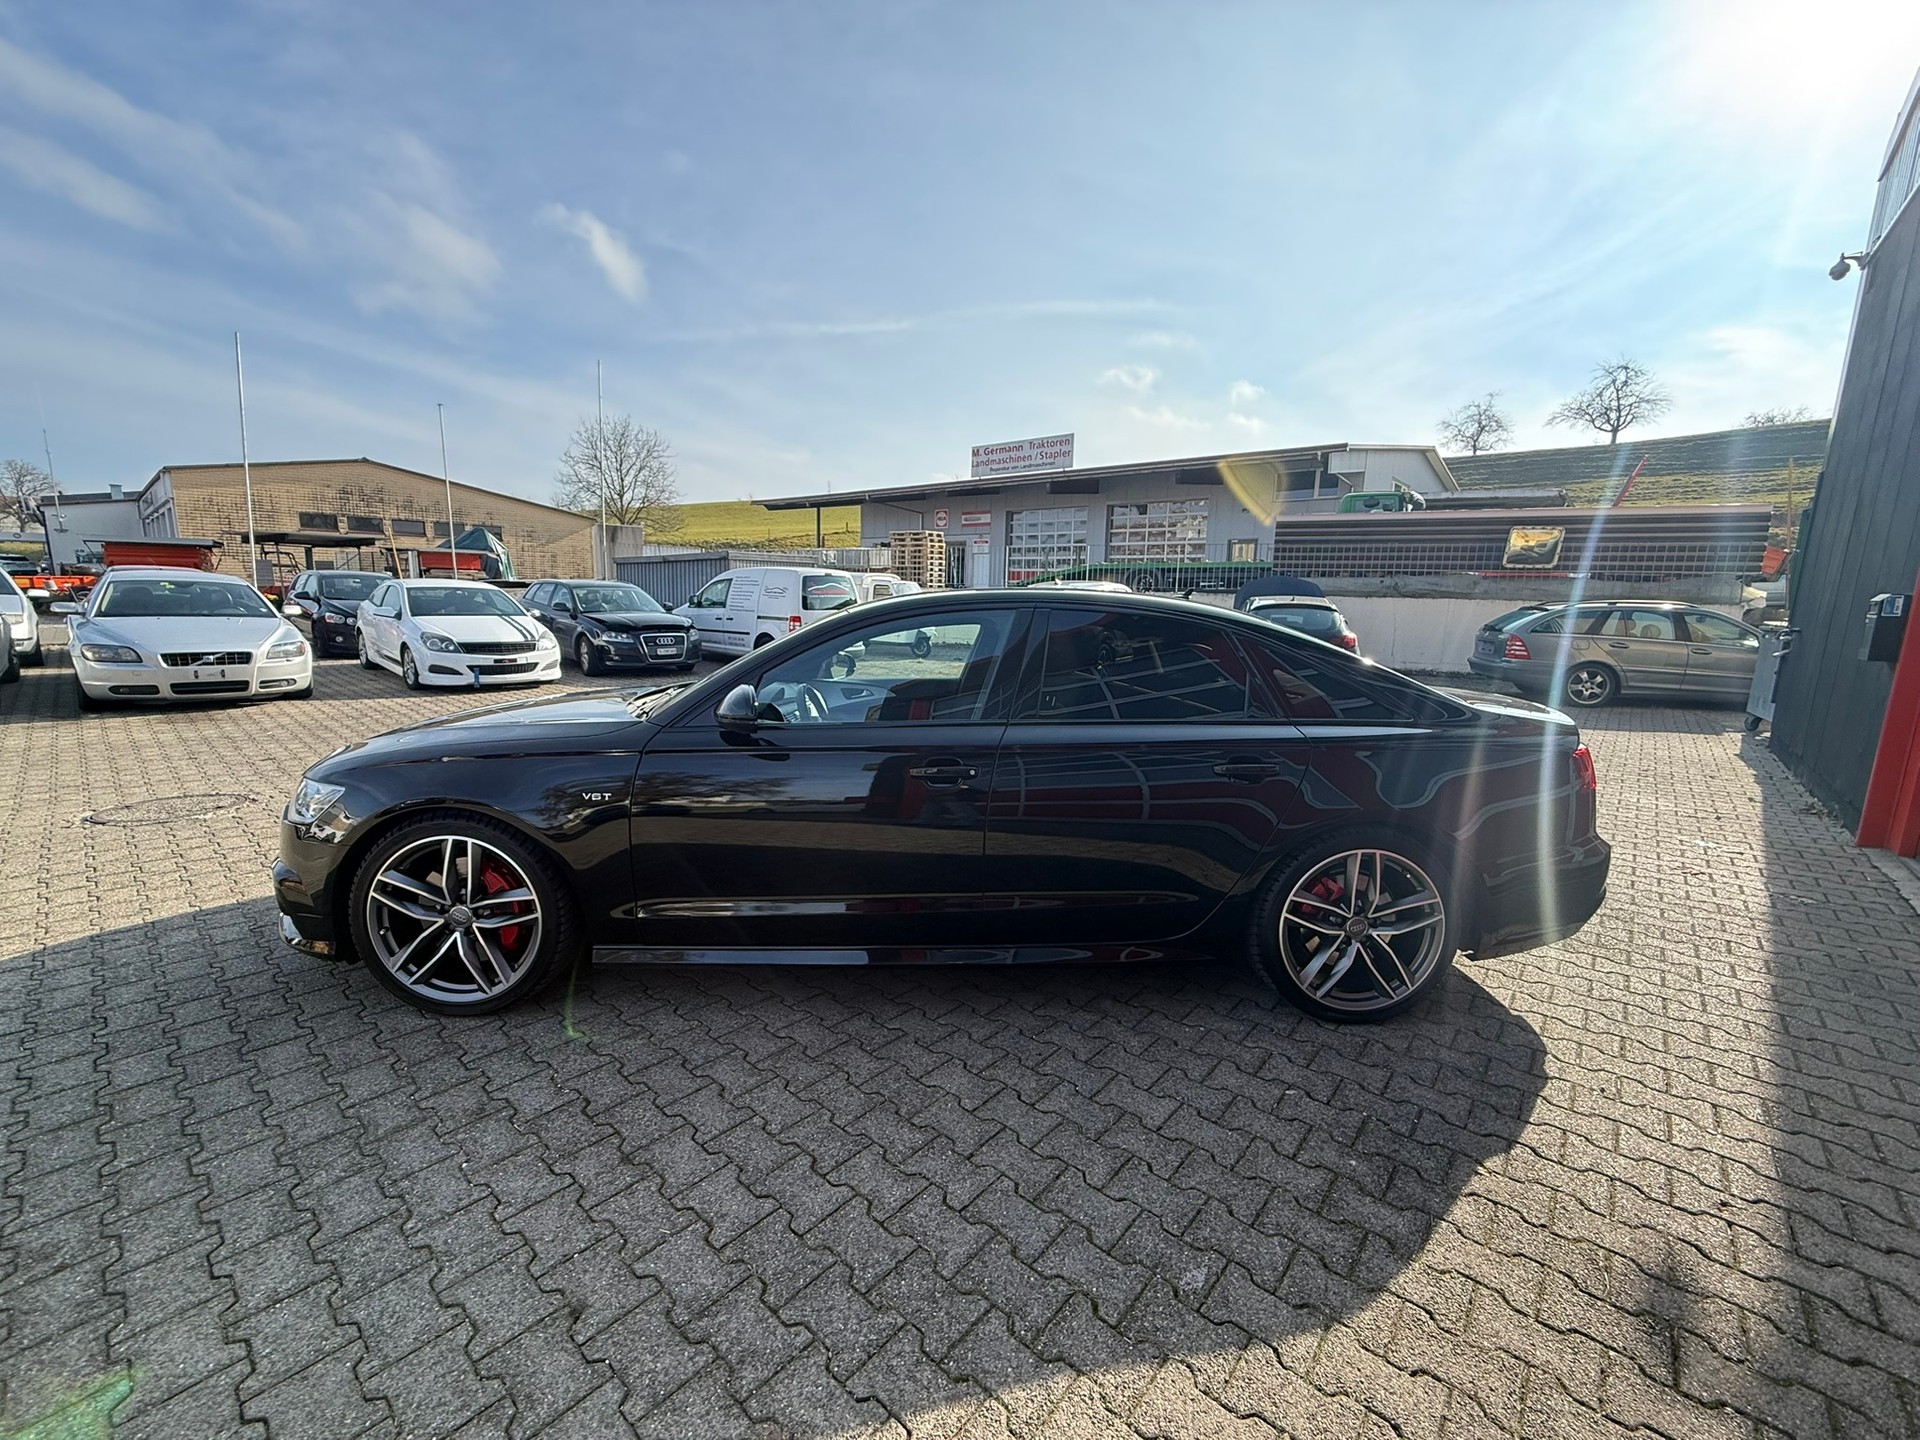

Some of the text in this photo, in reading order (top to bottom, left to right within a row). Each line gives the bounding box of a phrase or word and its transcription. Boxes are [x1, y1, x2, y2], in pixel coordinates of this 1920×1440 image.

[972, 438, 1070, 457] M. Germann Traktoren
[972, 454, 1032, 468] Landmaschinen
[582, 792, 612, 801] V6T
